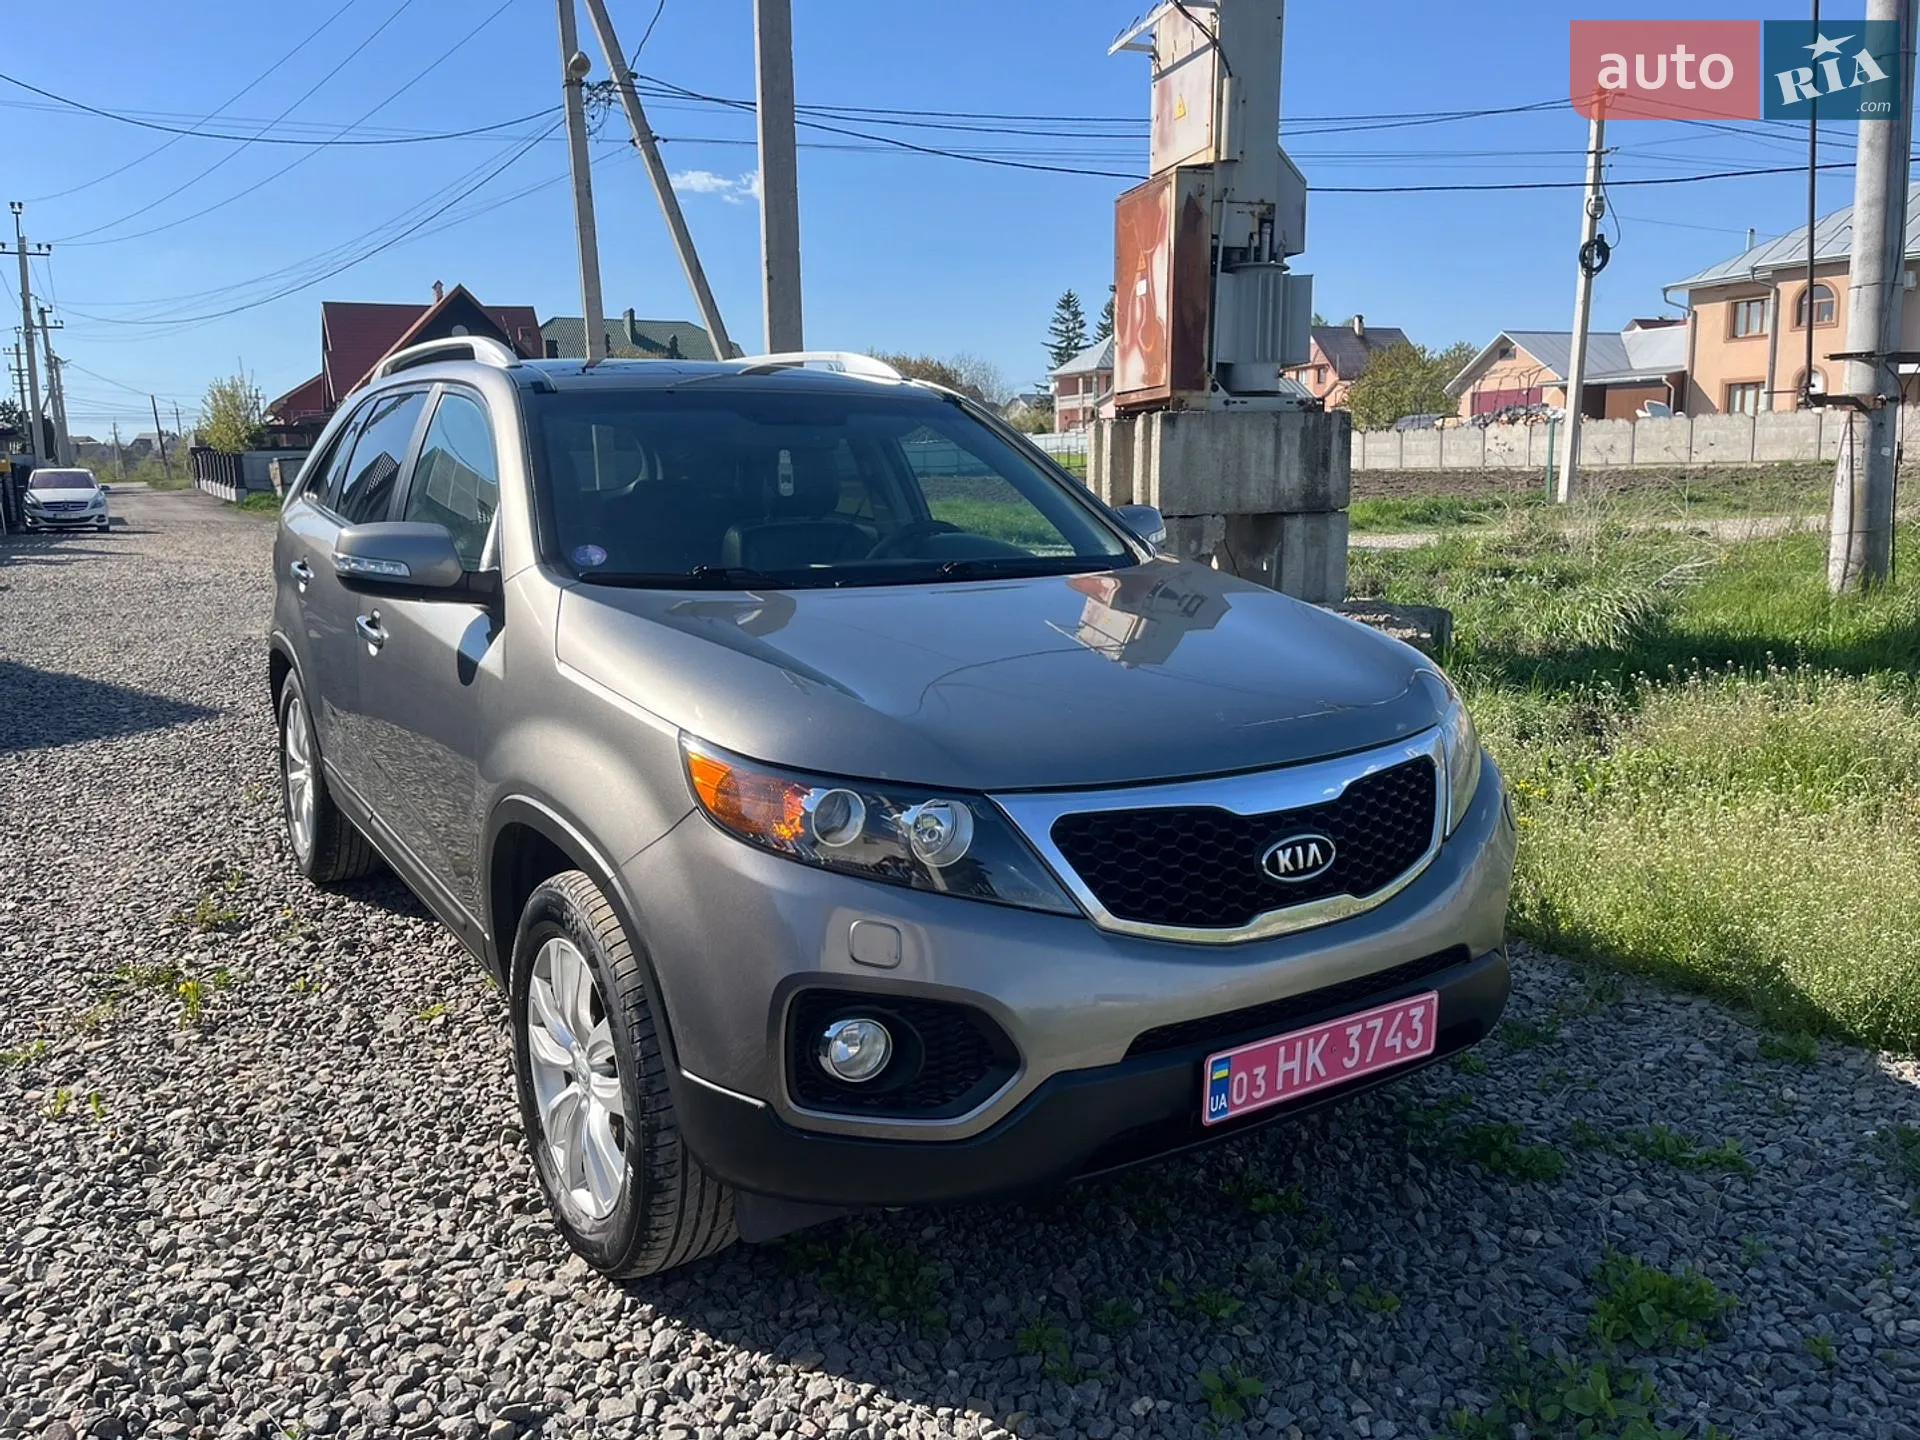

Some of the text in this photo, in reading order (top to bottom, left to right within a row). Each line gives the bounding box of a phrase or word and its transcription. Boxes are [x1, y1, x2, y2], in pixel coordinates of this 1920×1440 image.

[1276, 842, 1323, 873] KIA
[1232, 1005, 1425, 1105] 03 HK 3743
[1210, 1093, 1228, 1112] UA
